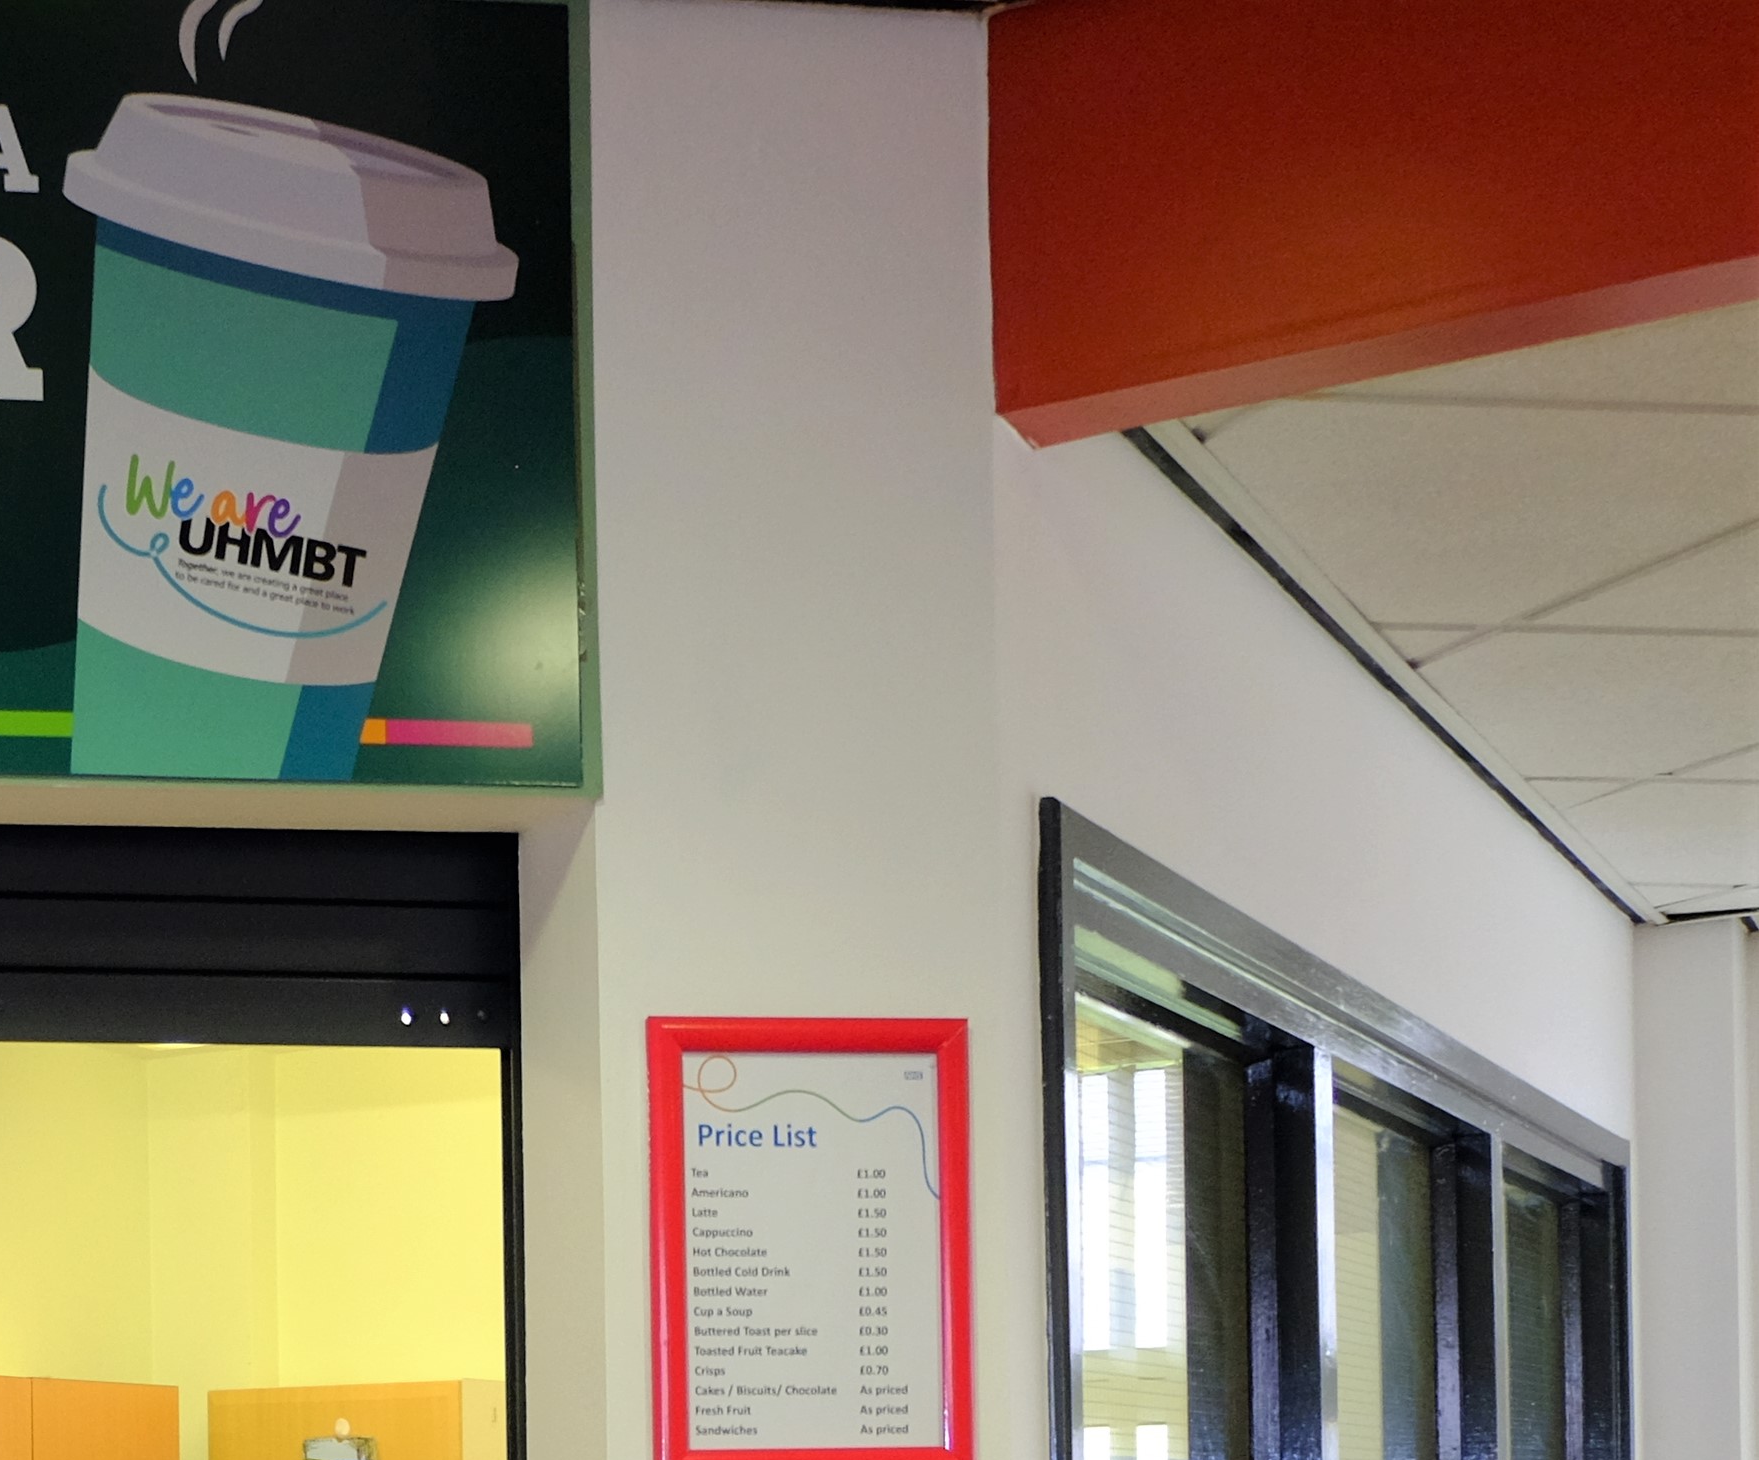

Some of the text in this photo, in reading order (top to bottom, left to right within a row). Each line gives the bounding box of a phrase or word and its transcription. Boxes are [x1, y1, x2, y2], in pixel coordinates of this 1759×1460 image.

[125, 453, 301, 538] We are
[178, 516, 367, 587] UHMBT
[221, 569, 235, 578] we
[238, 572, 252, 581] are
[253, 576, 290, 591] creating
[299, 585, 323, 597] great
[325, 589, 350, 603] place
[175, 571, 185, 580] to
[187, 572, 198, 583] be
[200, 577, 226, 589] cared
[227, 581, 240, 592] for
[243, 585, 260, 596] and
[270, 591, 293, 604] great
[295, 595, 319, 609] place
[321, 602, 331, 611] to
[332, 605, 354, 616] work
[698, 1123, 817, 1148] Price List
[691, 1167, 886, 1179] Tea £1.00
[691, 1187, 887, 1199] Americano £1.00
[691, 1207, 887, 1219] Latte £1.50
[692, 1226, 888, 1239] Cappuccino £1.50
[692, 1247, 888, 1258] Hot Chocolate £1.50
[692, 1266, 888, 1278] Bottled Cold Drink £1.50
[693, 1286, 888, 1297] Bottled Water £1.00
[693, 1306, 714, 1318] Cup
[725, 1306, 753, 1319] Soup
[858, 1306, 888, 1317] £0.45
[694, 1325, 889, 1338] Buttered Toast per slice £0.30
[694, 1345, 889, 1357] Toasted Fruit Teacake £1.00
[694, 1365, 889, 1377] Crisps £0.70
[694, 1385, 726, 1396] Cakes
[736, 1384, 783, 1397] Biscuits/
[784, 1385, 838, 1396] Chocolate
[859, 1385, 873, 1395] As
[875, 1384, 909, 1397] priced
[695, 1404, 909, 1417] Fresh Fruit As priced
[695, 1424, 909, 1436] Sandwiches As priced
